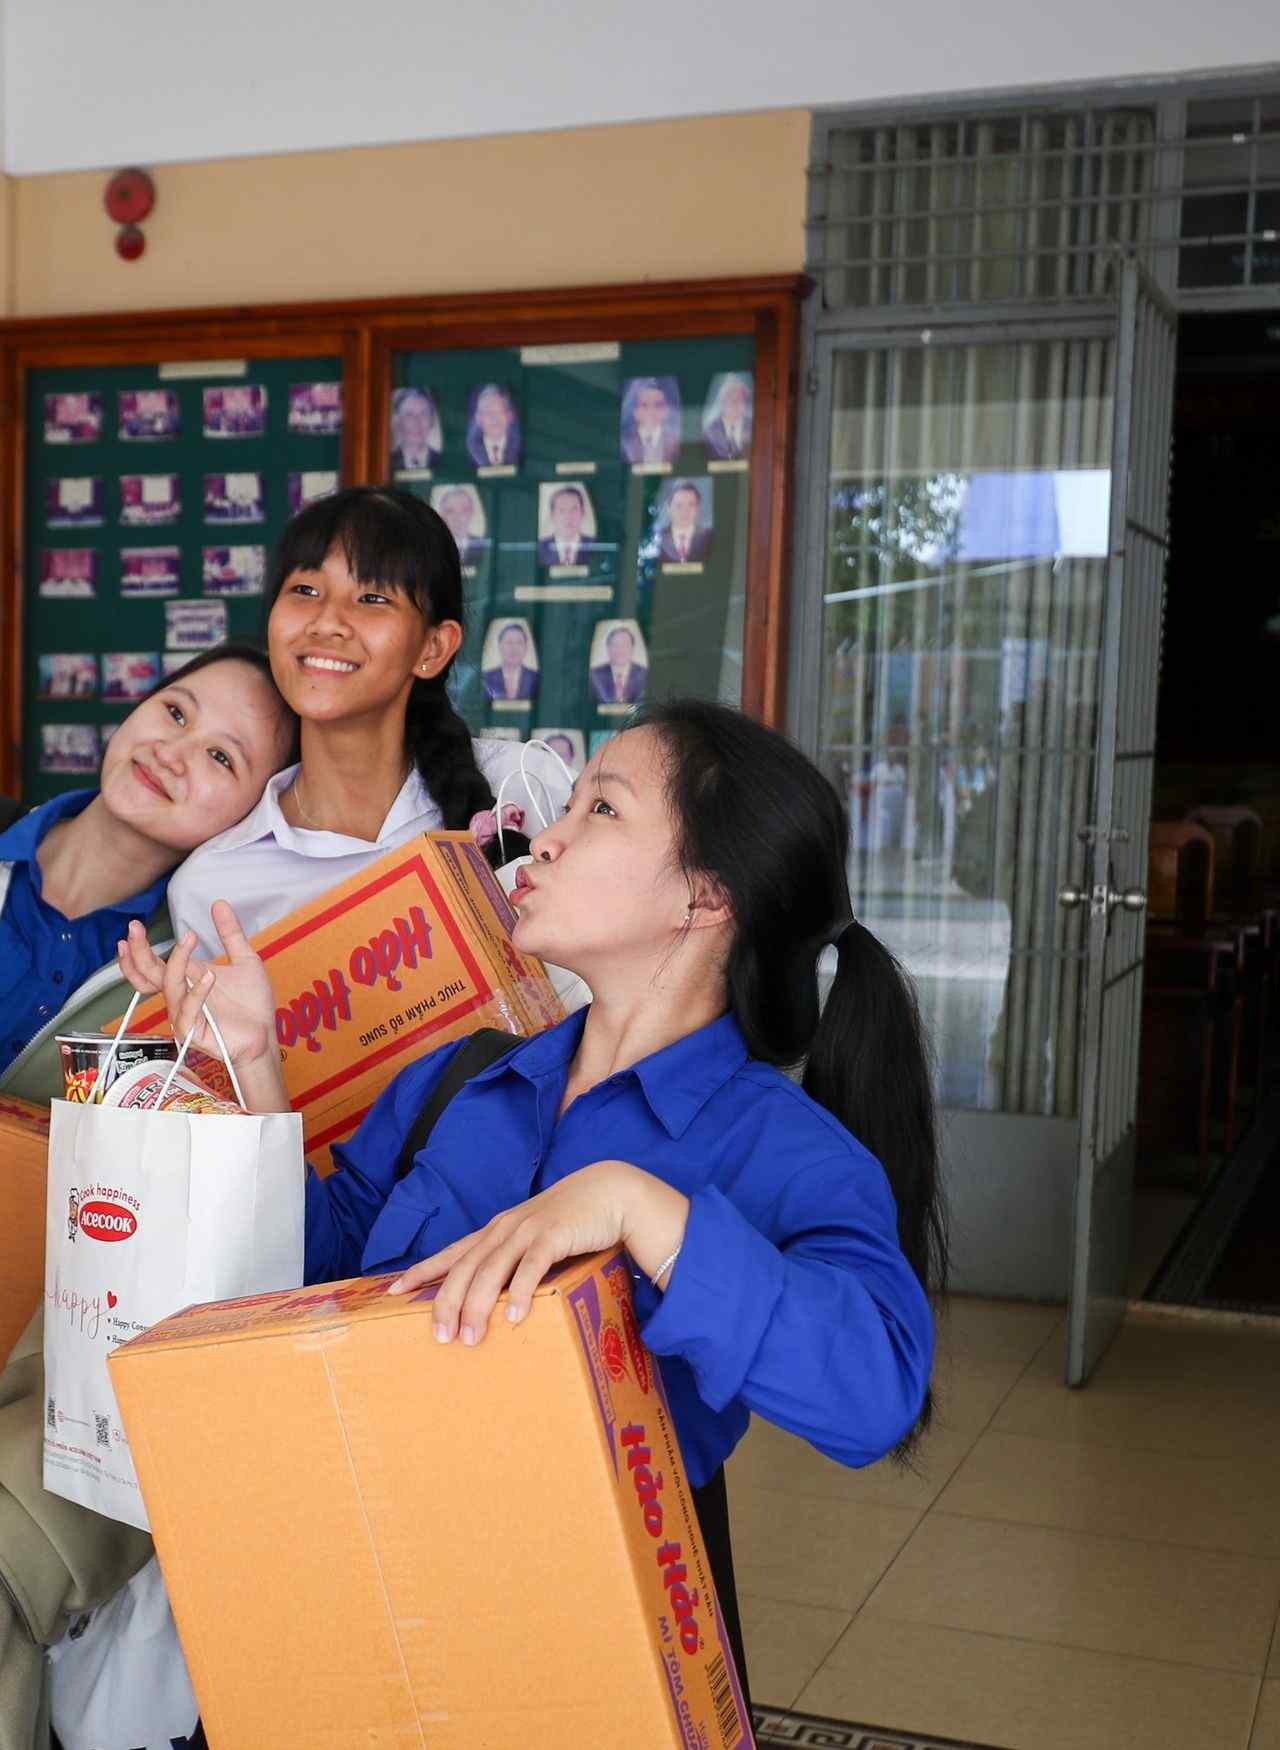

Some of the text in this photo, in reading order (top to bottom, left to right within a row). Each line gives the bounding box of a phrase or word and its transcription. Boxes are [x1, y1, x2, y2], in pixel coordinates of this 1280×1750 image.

[349, 906, 433, 991] Hảo
[275, 969, 352, 1053] Hảo
[359, 978, 467, 1047] THỰC PHẨM BỔ SUNG
[81, 1182, 140, 1211] Cook happiness
[621, 1421, 663, 1538] Hảo
[657, 1539, 699, 1655] Hảo
[668, 1647, 684, 1696] TÔM
